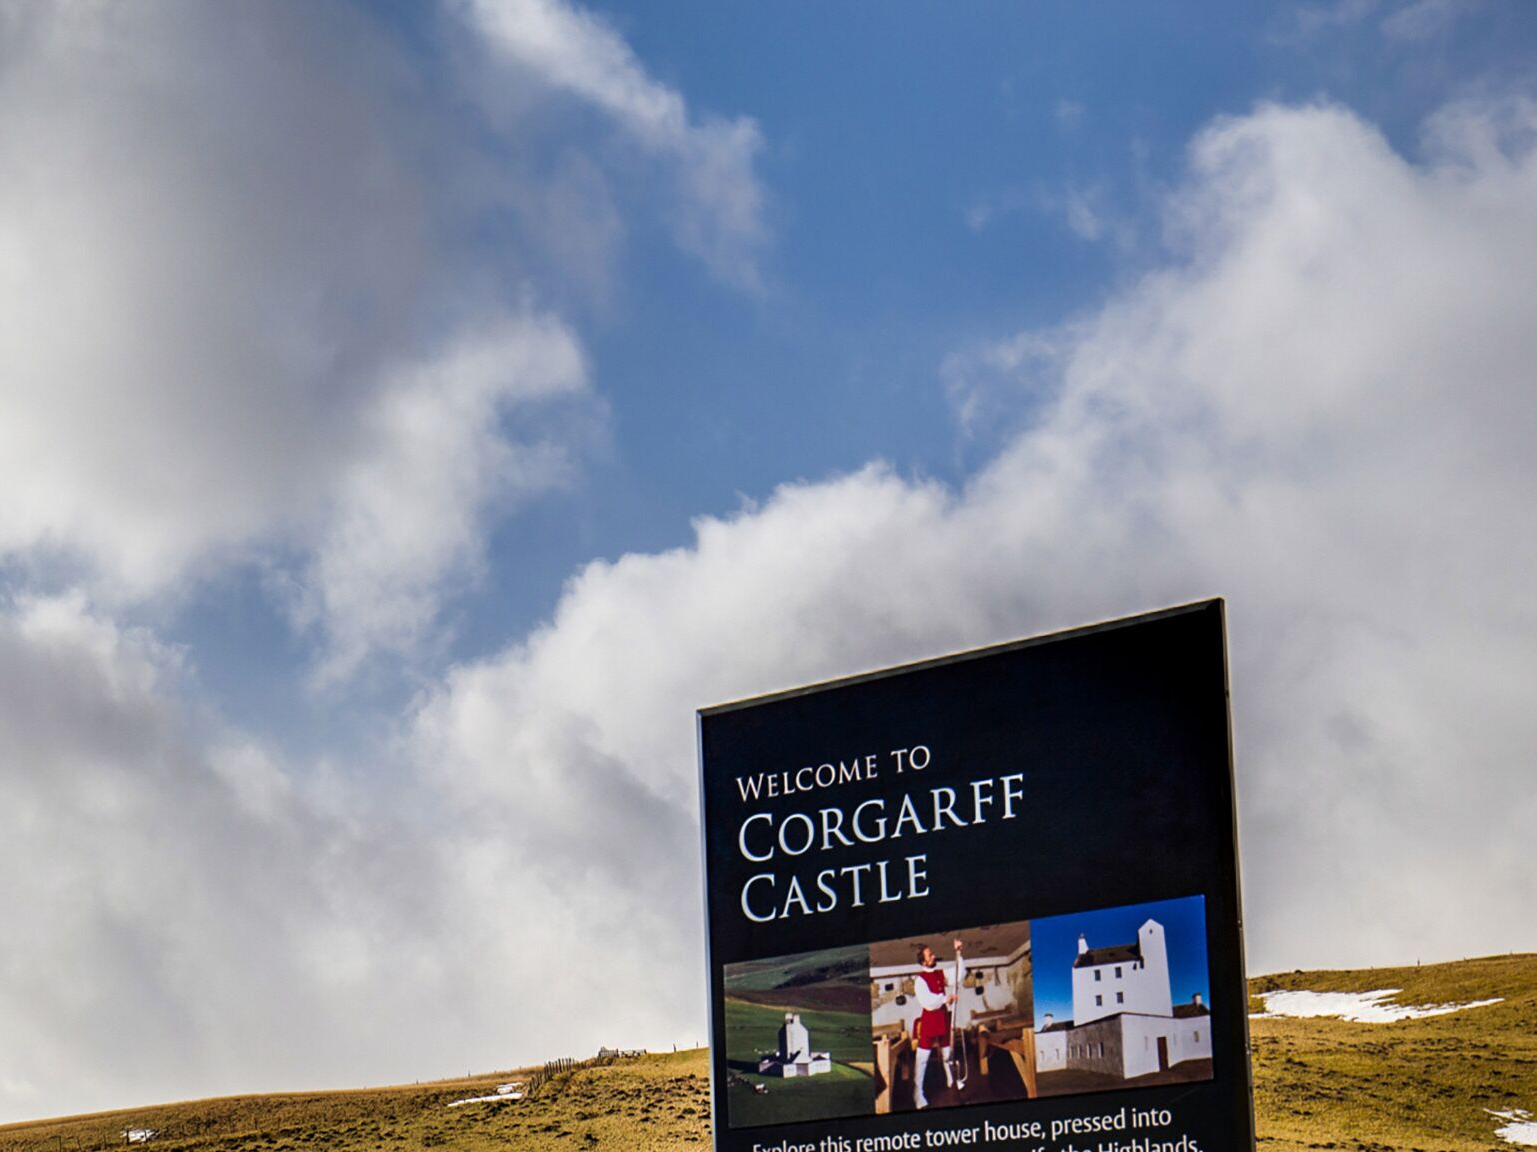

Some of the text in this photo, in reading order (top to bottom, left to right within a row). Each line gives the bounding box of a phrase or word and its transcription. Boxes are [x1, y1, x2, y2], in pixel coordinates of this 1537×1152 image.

[737, 746, 930, 802] WELCOME TO
[739, 773, 1024, 862] CORGARFF
[742, 854, 930, 922] CASTLE
[857, 1132, 920, 1152] remote
[925, 1128, 980, 1146] tower
[985, 1121, 1045, 1141] house,
[1052, 1108, 1125, 1141] pressed
[1132, 1108, 1171, 1128] into
